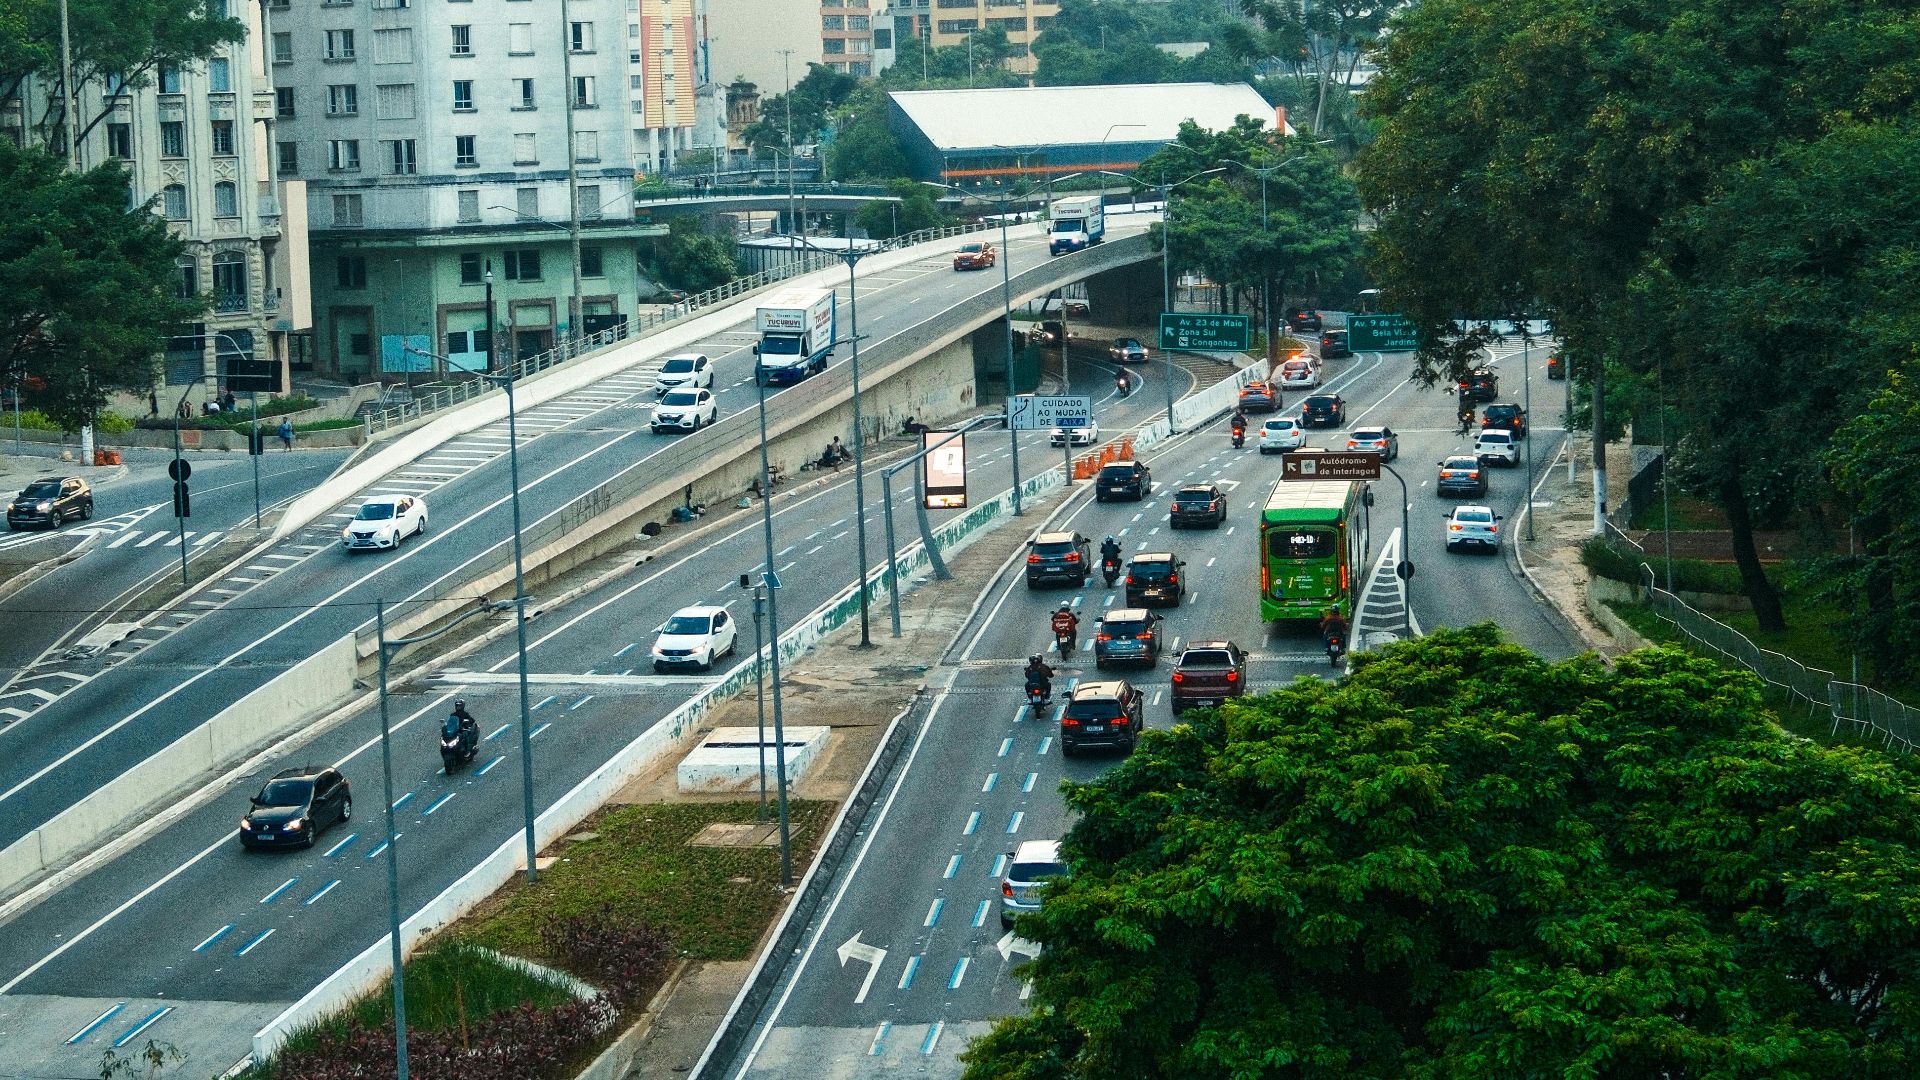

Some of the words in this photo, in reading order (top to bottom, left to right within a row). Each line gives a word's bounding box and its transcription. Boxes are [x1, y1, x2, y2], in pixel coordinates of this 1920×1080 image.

[1195, 319, 1207, 327] 23
[1209, 319, 1220, 327] de
[1223, 319, 1243, 327] Maio
[1370, 319, 1376, 327] 9
[1379, 319, 1390, 327] de
[1179, 328, 1200, 336] Zona
[1203, 328, 1216, 336] Sul
[1372, 328, 1392, 337] Bela
[1191, 338, 1238, 348] Congonhas
[1384, 338, 1417, 346] Jardins
[1042, 399, 1083, 407] CUIDADO
[1037, 409, 1050, 417] AO
[1040, 418, 1052, 426] DE
[1056, 418, 1085, 426] FAIXA
[1319, 457, 1367, 465] Autódromo
[1333, 468, 1376, 476] Interlagos
